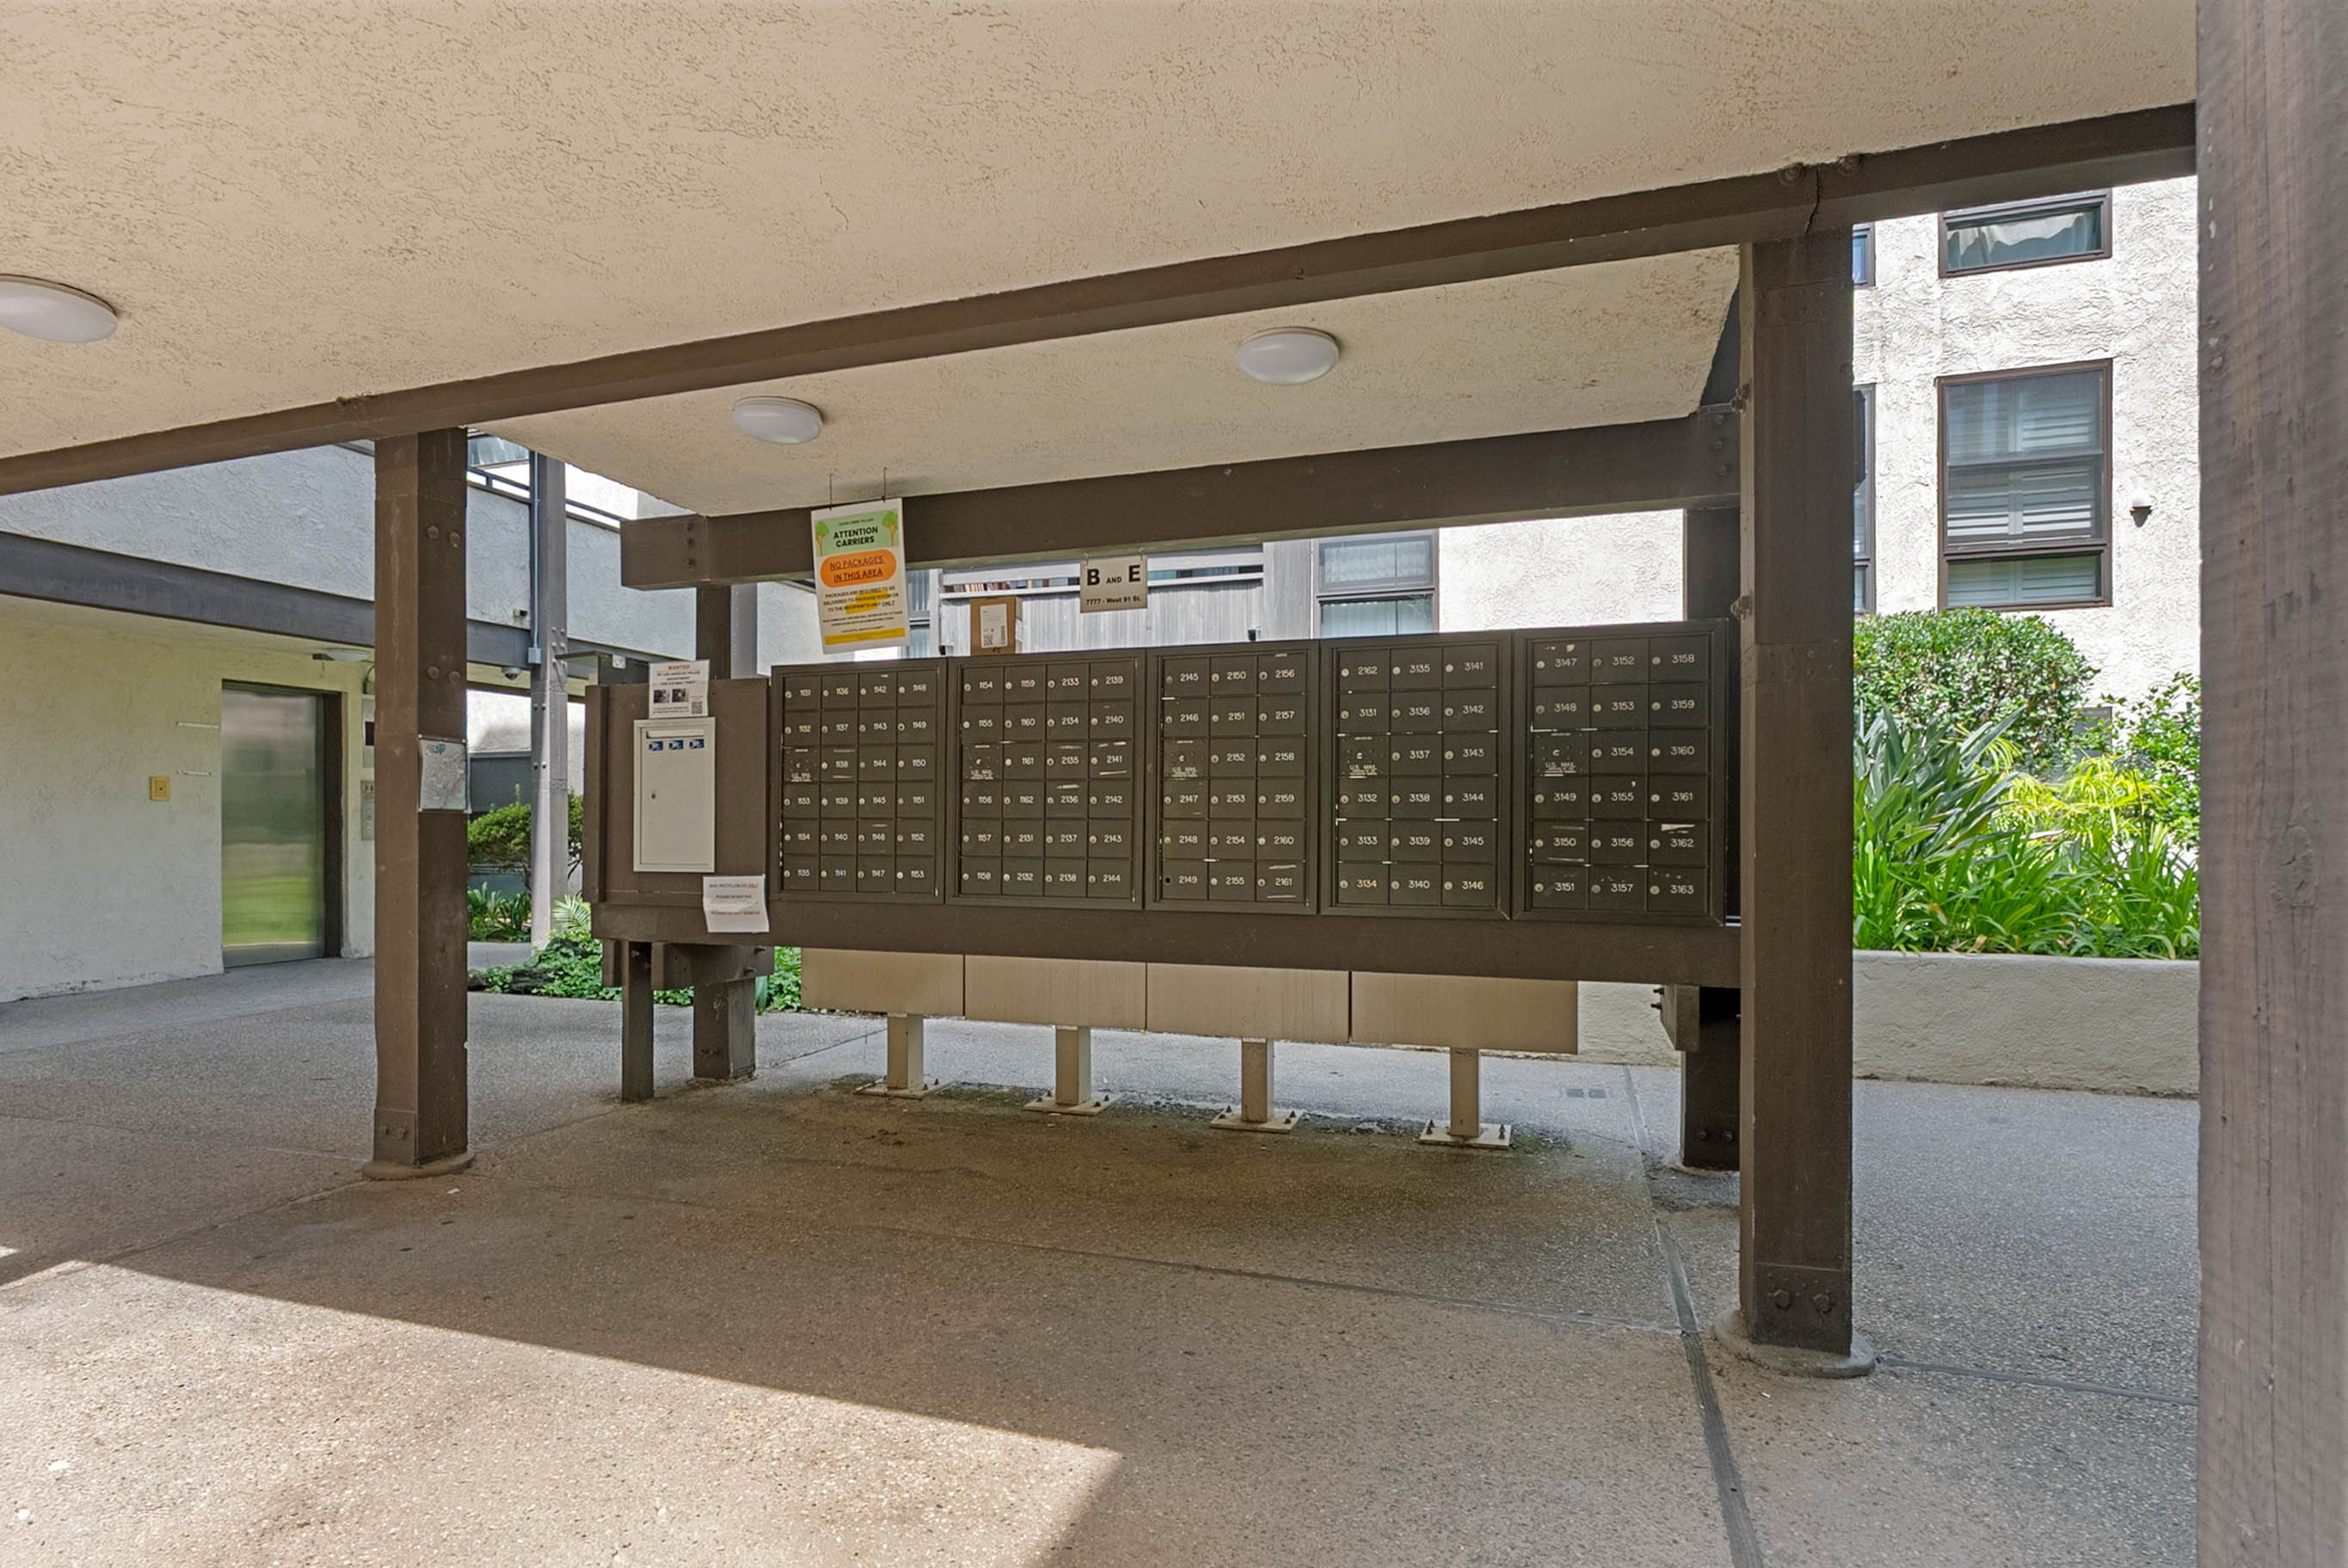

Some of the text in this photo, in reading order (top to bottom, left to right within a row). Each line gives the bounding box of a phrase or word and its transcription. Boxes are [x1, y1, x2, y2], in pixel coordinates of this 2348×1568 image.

[833, 526, 878, 539] ATTENTION
[836, 536, 875, 547] CARRIERS
[830, 556, 884, 570] NO PACKAGES
[844, 571, 861, 581] THIS
[862, 568, 883, 578] AREA
[1087, 569, 1100, 586] B
[1128, 564, 1140, 582] E
[1554, 657, 1577, 668] 3147
[1612, 655, 1635, 666] 3152
[1671, 653, 1695, 664] 3158
[1357, 666, 1378, 675] 2162
[1409, 663, 1431, 673] 3135
[1464, 661, 1484, 672] 3141
[1179, 672, 1199, 682] 2145
[1226, 670, 1247, 680] 2150
[1275, 668, 1295, 679] 2156
[979, 680, 993, 690] 1154
[1020, 679, 1036, 688] 1159
[1061, 677, 1080, 686] 2133
[1105, 675, 1124, 685] 2139
[799, 688, 812, 697] 1131
[836, 687, 850, 696] 1136
[873, 685, 888, 694] 1142
[913, 683, 927, 692] 1148
[1462, 704, 1484, 715] 3142
[1554, 702, 1577, 713] 3148
[1611, 701, 1635, 711] 3153
[1670, 699, 1695, 710] 3159
[1227, 711, 1245, 721] 2151
[1275, 710, 1295, 720] 2157
[1359, 708, 1377, 717] 3131
[1409, 706, 1430, 716] 3136
[1020, 717, 1036, 727] 1160
[1061, 716, 1079, 726] 2134
[1104, 715, 1124, 724] 2140
[1180, 713, 1199, 723] 2146
[798, 724, 812, 733] 1132
[835, 723, 849, 732] 1137
[873, 722, 888, 730] 1143
[912, 721, 927, 729] 1149
[978, 719, 993, 728] 1155
[1409, 749, 1430, 759] 3137
[1462, 747, 1484, 758] 3143
[1610, 747, 1634, 757] 3154
[1669, 745, 1695, 756] 3160
[1021, 756, 1035, 766] 1161
[1061, 756, 1079, 765] 2135
[1106, 754, 1122, 764] 2141
[1226, 753, 1245, 762] 2152
[1275, 752, 1295, 761] 2158
[835, 759, 849, 769] 1138
[912, 759, 927, 767] 1150
[797, 796, 811, 805] 1133
[835, 796, 849, 805] 1139
[872, 796, 887, 805] 1145
[913, 796, 925, 804] 1151
[978, 796, 993, 804] 1156
[1019, 795, 1035, 804] 1162
[1060, 795, 1079, 804] 2136
[1104, 795, 1123, 804] 2142
[1179, 794, 1199, 803] 2147
[1226, 794, 1246, 803] 2153
[1275, 794, 1295, 803] 2159
[1357, 793, 1378, 802] 3132
[1409, 793, 1430, 802] 3138
[1462, 792, 1484, 802] 3144
[1553, 792, 1577, 802] 3149
[1610, 791, 1635, 802] 3155
[1671, 791, 1693, 802] 3161
[797, 833, 811, 841] 1134
[834, 833, 849, 841] 1140
[871, 833, 886, 841] 1146
[911, 833, 925, 842] 1152
[977, 833, 992, 842] 1157
[1018, 833, 1034, 843] 2131
[1060, 833, 1078, 843] 2137
[1103, 833, 1122, 843] 2143
[1178, 834, 1198, 844] 2148
[1226, 835, 1245, 845] 2154
[1273, 835, 1294, 845] 2160
[1357, 835, 1378, 845] 3133
[1409, 836, 1431, 845] 3139
[1462, 836, 1484, 846] 3145
[1553, 837, 1577, 847] 3150
[1610, 837, 1634, 847] 3156
[1669, 838, 1694, 848] 3162
[797, 869, 811, 877] 1135
[834, 869, 847, 877] 1141
[871, 869, 886, 877] 1147
[910, 870, 925, 879] 1153
[976, 871, 992, 881] 1158
[1017, 872, 1034, 882] 2132
[1059, 873, 1077, 882] 2138
[1103, 874, 1122, 882] 2144
[1178, 875, 1198, 884] 2149
[1225, 876, 1245, 885] 2155
[1275, 876, 1293, 887] 2161
[1356, 879, 1377, 889] 3134
[1408, 879, 1430, 889] 3140
[1461, 880, 1484, 890] 3146
[1554, 882, 1575, 892] 3151
[1610, 882, 1634, 893] 3157
[1669, 884, 1694, 895] 3163
